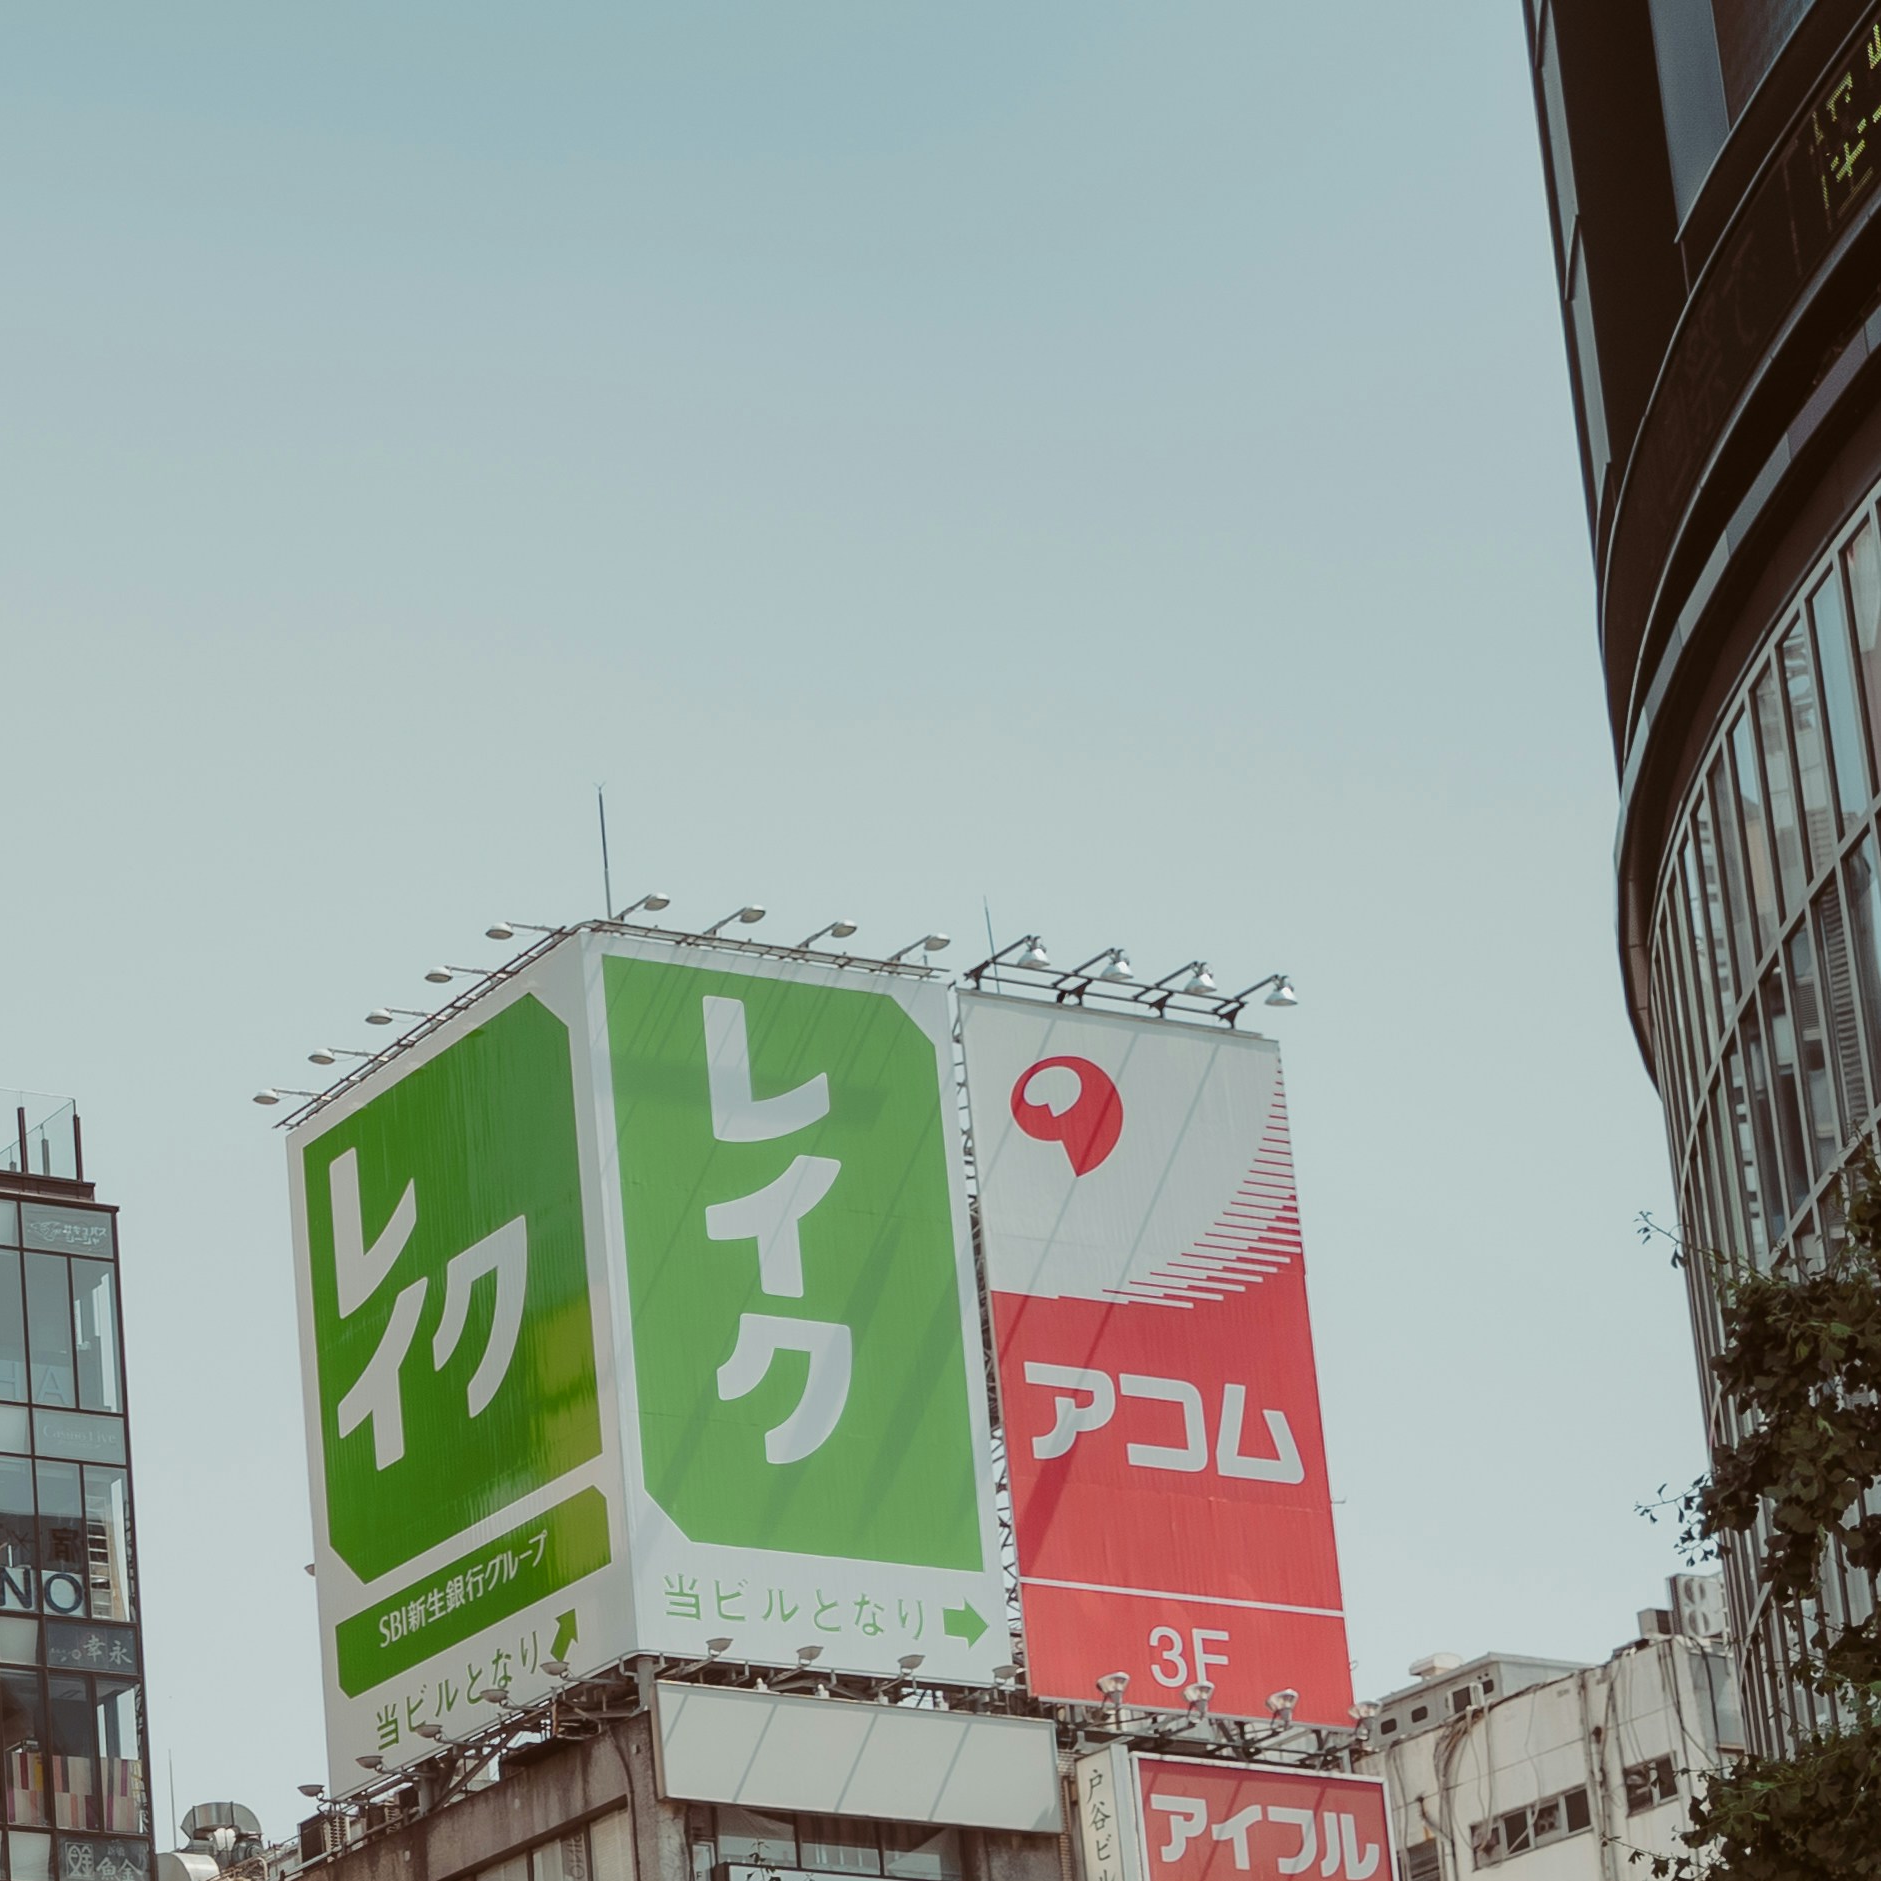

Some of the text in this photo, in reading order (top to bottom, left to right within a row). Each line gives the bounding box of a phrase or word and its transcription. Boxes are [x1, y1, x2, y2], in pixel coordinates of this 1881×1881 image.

[702, 994, 852, 1466] レイク
[327, 1145, 528, 1472] レイク
[1023, 1360, 1305, 1485] アコム
[377, 1526, 549, 1650] SBI新生銀行グループ
[663, 1572, 927, 1642] 当ビルとなり
[375, 1632, 541, 1752] 当ビルとなり
[1148, 1627, 1231, 1690] 3F
[1150, 1792, 1381, 1881] アイフル
